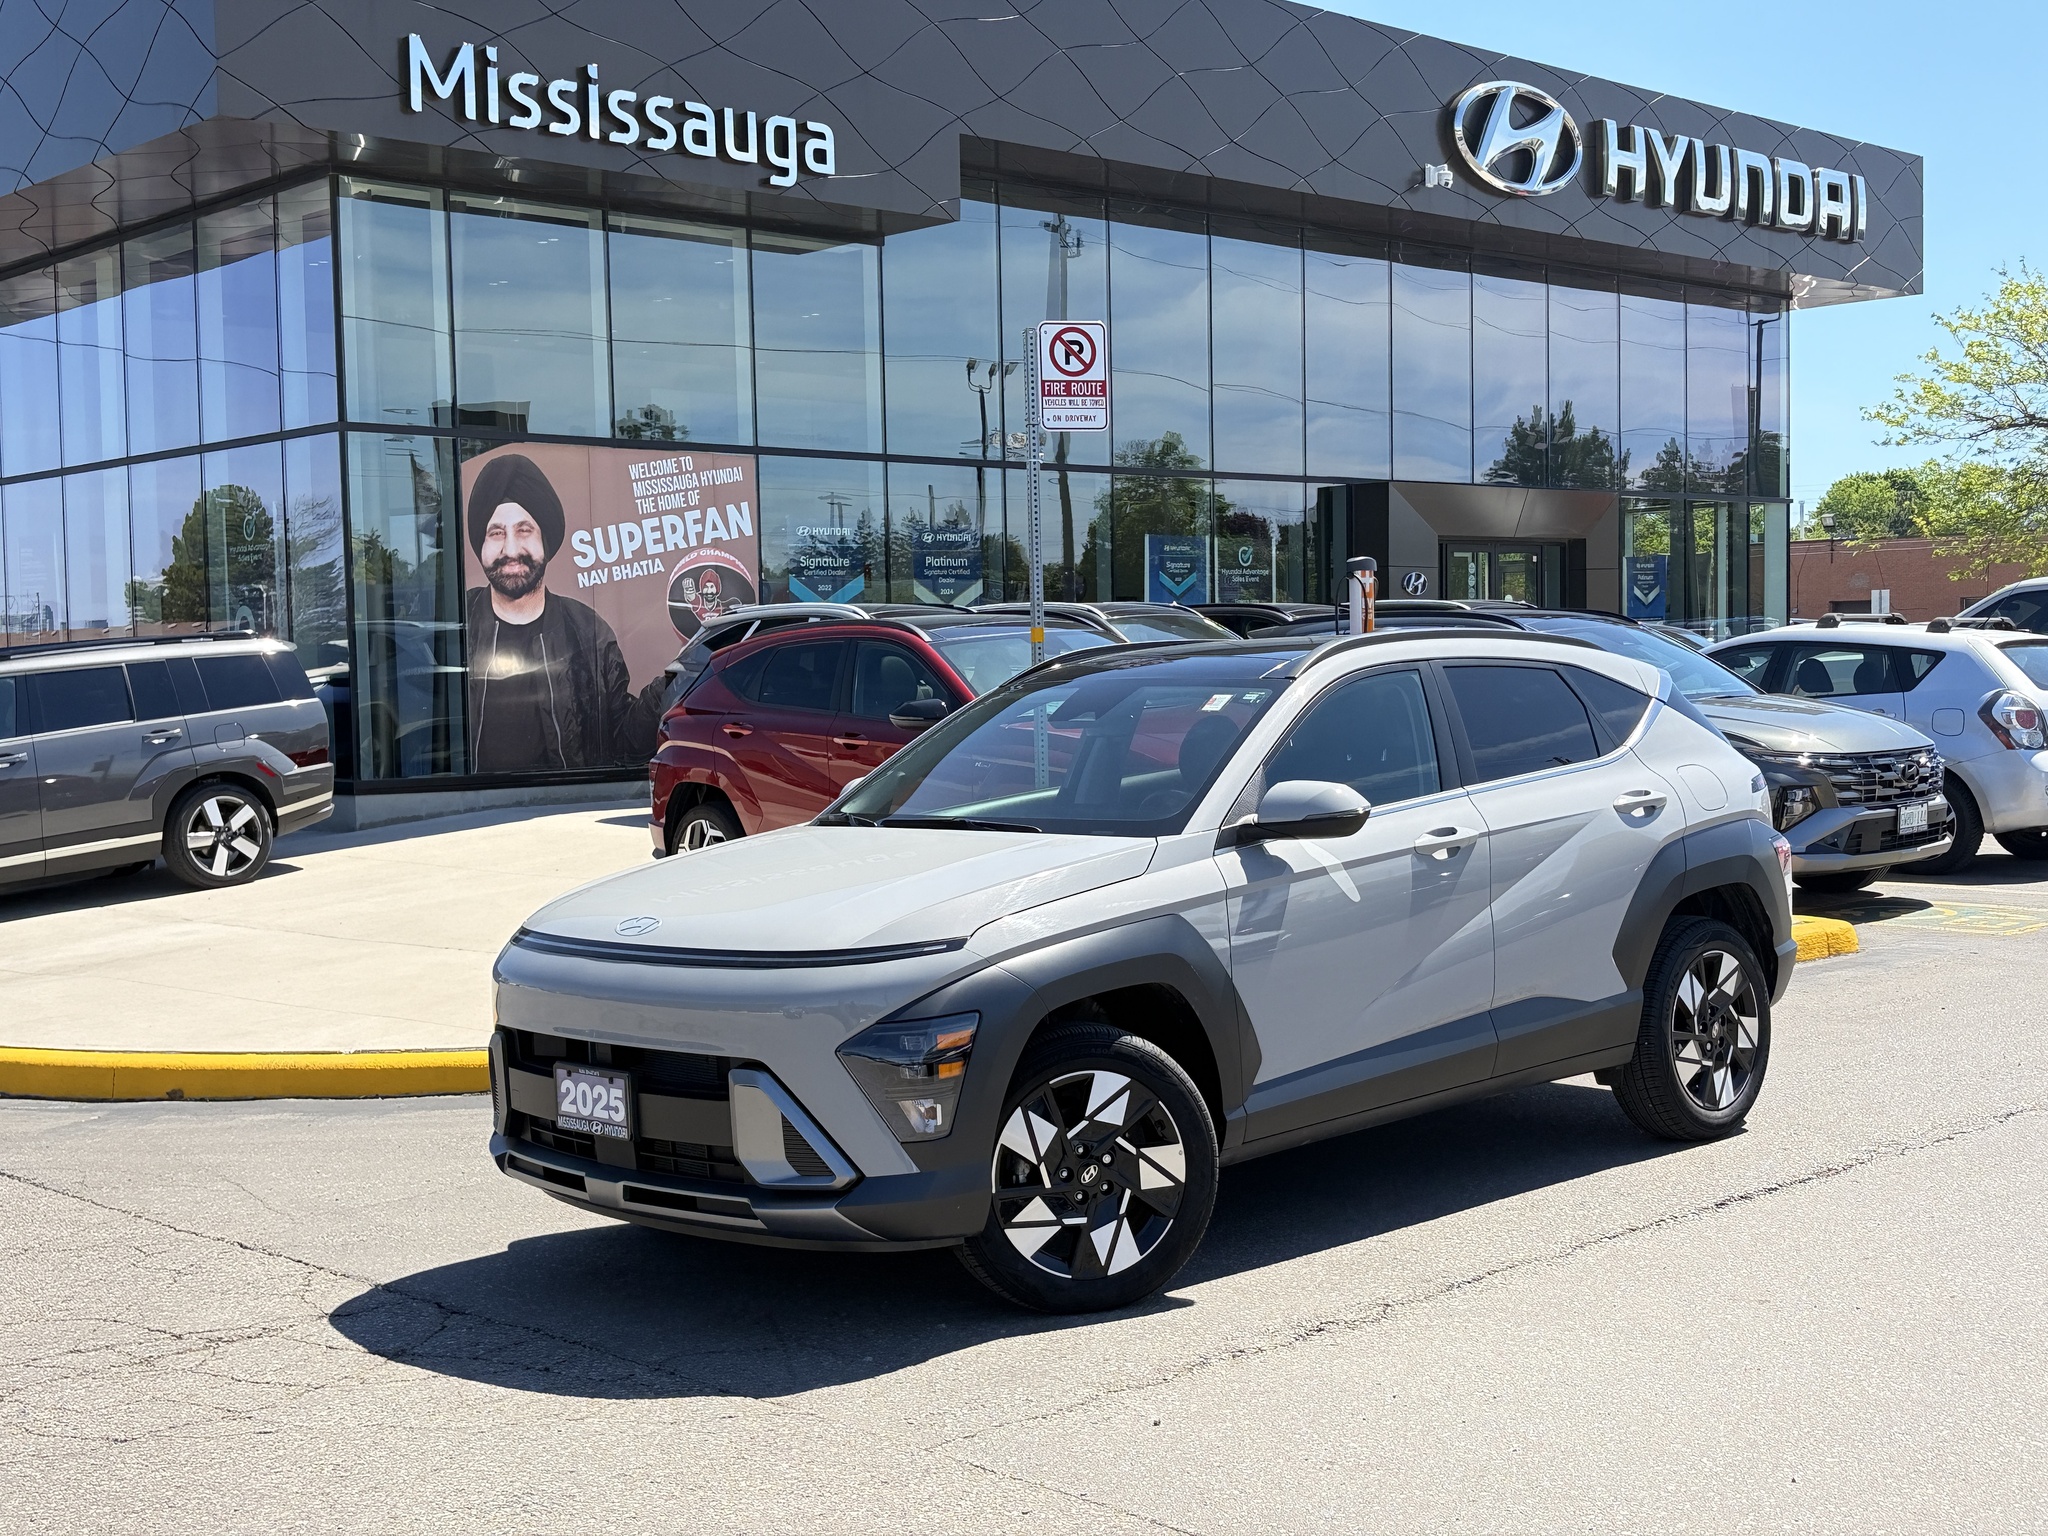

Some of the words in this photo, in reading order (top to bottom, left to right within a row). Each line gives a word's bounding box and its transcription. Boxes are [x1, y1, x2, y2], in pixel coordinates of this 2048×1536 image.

[408, 32, 835, 187] Mississauga
[1601, 117, 1867, 243] HYUNDAI
[1044, 382, 1067, 396] FIRE
[1071, 382, 1104, 395] ROUTE
[1045, 399, 1067, 407] VEHICLES
[1068, 399, 1080, 407] WILL
[1081, 399, 1088, 407] BE
[629, 458, 679, 480] WELCOME
[680, 456, 694, 472] TO
[633, 473, 700, 498] MISSISSAUGA
[700, 466, 744, 487] HYUNDAI
[635, 498, 657, 515] THE
[658, 493, 687, 512] HOME
[688, 490, 701, 506] OF
[571, 501, 754, 569] SUPERFAN
[813, 527, 851, 536] HYUNDAI
[937, 534, 971, 542] HYUNDAI
[577, 568, 609, 589] NAV
[612, 558, 665, 582] BHATIA
[800, 555, 850, 569] Signature
[926, 556, 968, 567] Platinum
[561, 1079, 625, 1123] 2025
[557, 1116, 590, 1132] MISSISSAUGA
[604, 1124, 628, 1139] HYUNDAI
